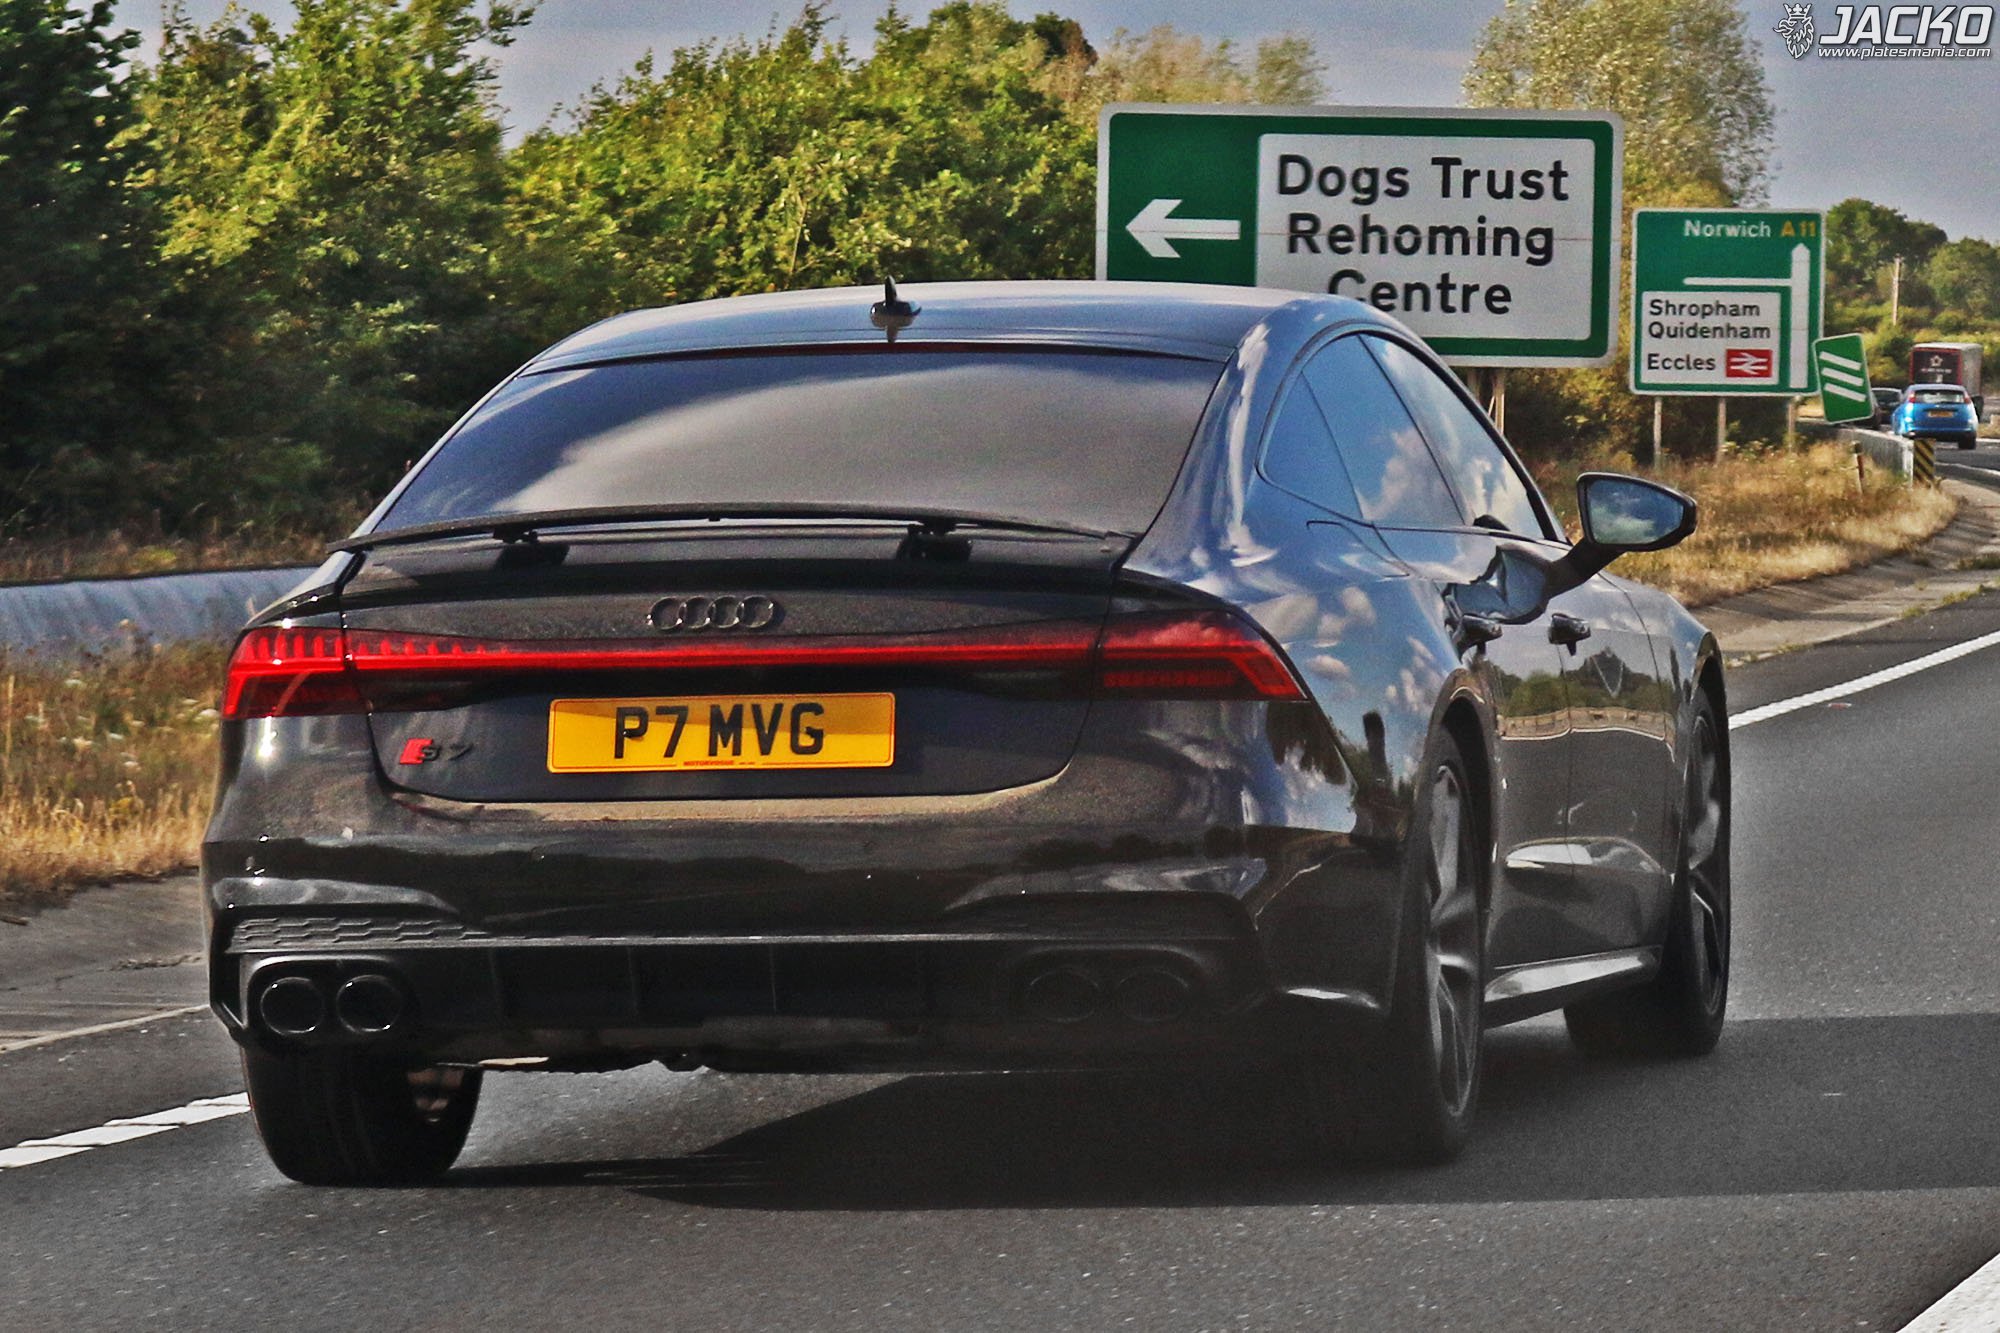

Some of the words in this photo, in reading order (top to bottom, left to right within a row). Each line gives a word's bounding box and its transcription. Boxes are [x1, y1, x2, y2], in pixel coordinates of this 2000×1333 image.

[1278, 154, 1409, 205] Dogs
[1430, 156, 1568, 200] Trust
[1288, 213, 1554, 267] Rehoming
[1684, 220, 1771, 238] Norwich
[1780, 221, 1816, 237] A11
[1327, 268, 1512, 314] Centre
[1649, 299, 1760, 319] Shropham
[1648, 321, 1771, 339] Quidenham
[1647, 353, 1716, 371] Eccles
[614, 706, 690, 759] P7
[707, 702, 825, 757] MVG
